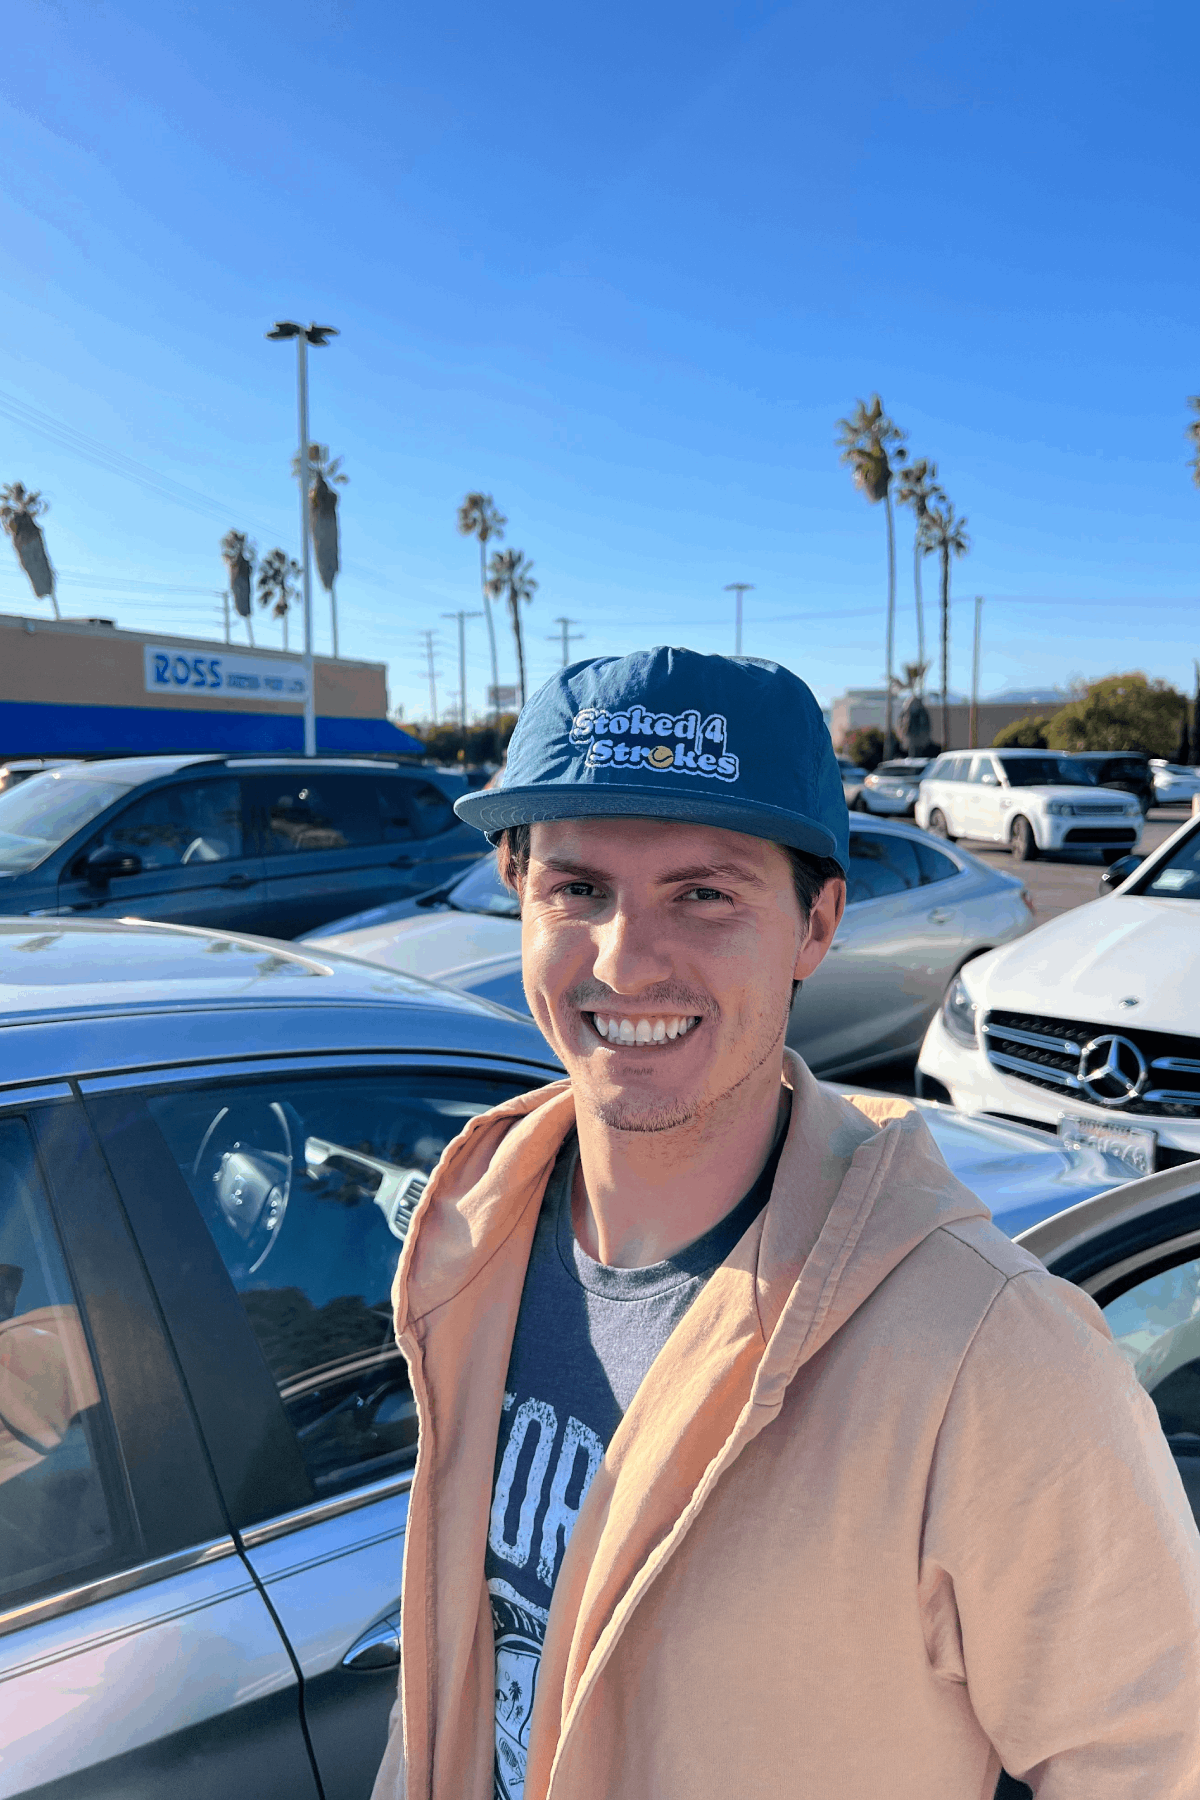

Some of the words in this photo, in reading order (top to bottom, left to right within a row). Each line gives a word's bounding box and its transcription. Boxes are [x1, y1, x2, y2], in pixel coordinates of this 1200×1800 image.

[154, 654, 222, 688] ROSS
[572, 708, 697, 741] Stoked
[704, 717, 725, 744] 4
[590, 738, 737, 775] Strokes
